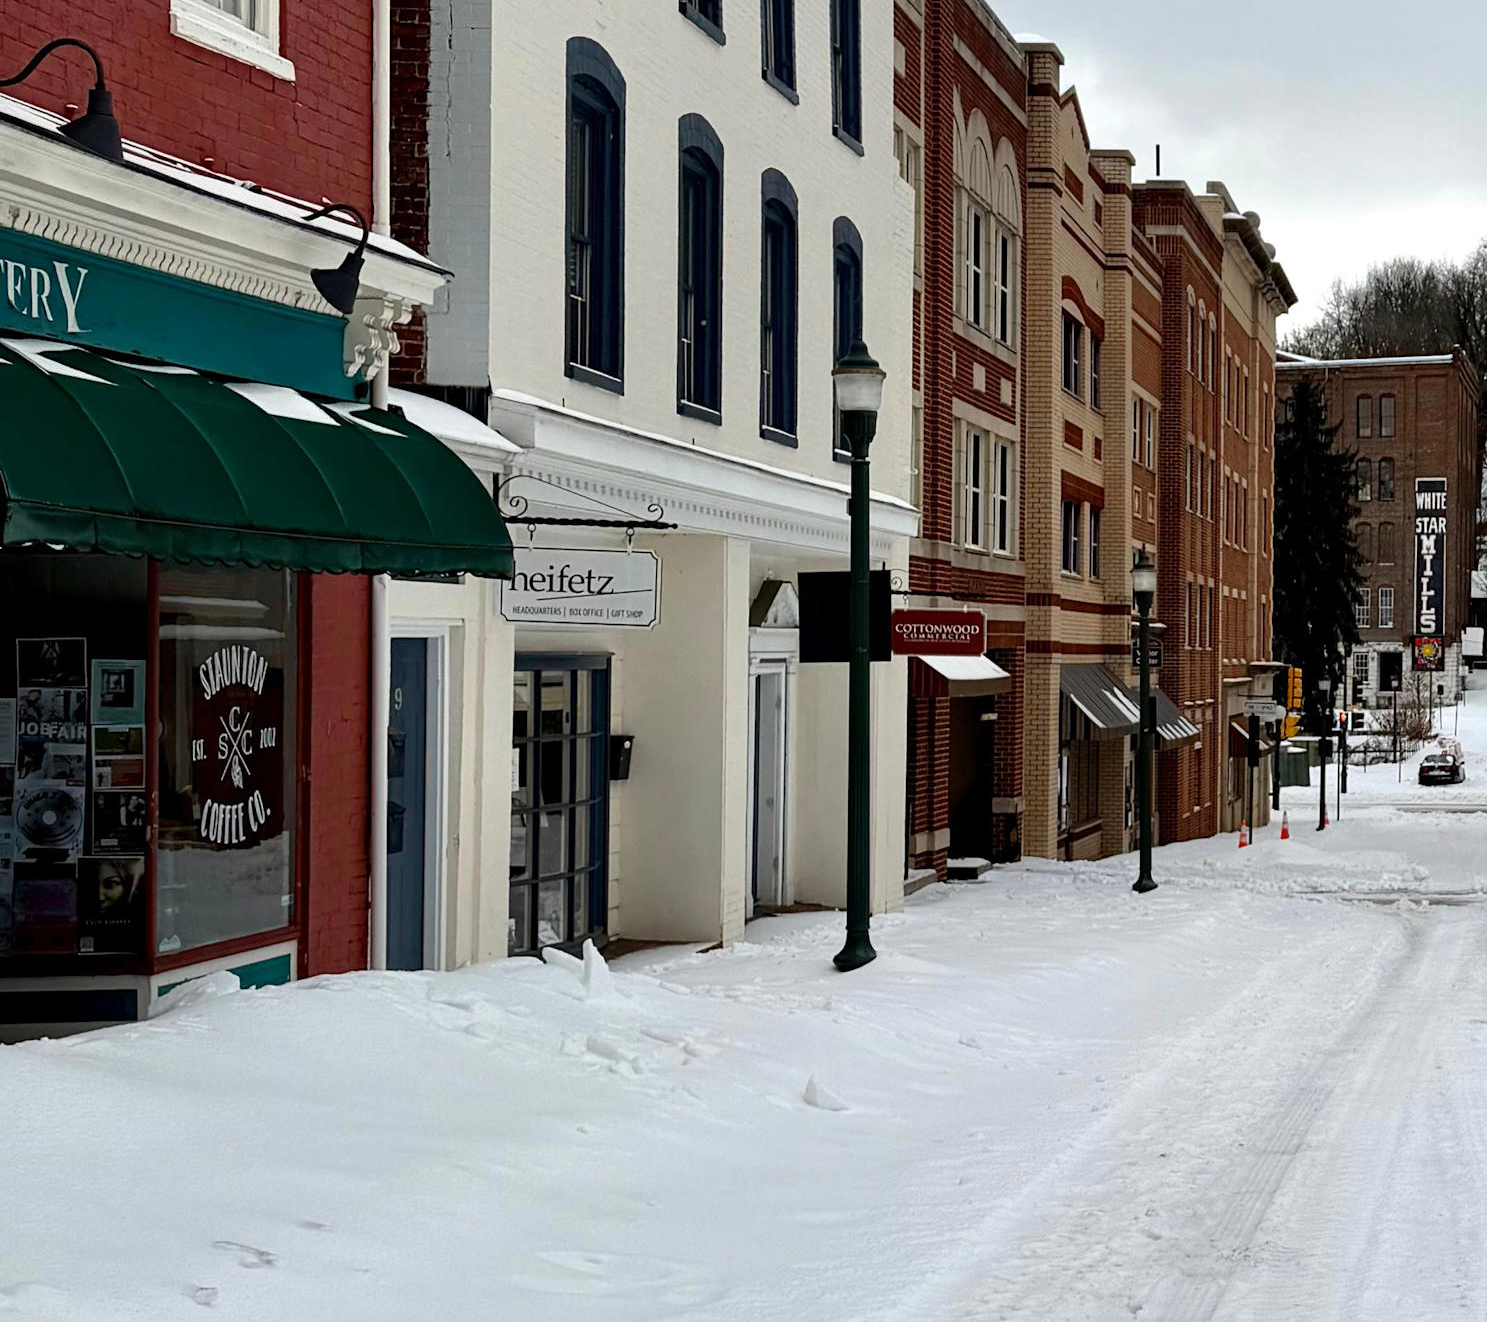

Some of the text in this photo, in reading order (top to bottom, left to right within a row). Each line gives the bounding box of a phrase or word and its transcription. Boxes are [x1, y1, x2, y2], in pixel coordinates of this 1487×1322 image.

[0, 259, 92, 333] ERY
[1415, 492, 1447, 510] WHITE
[1415, 517, 1447, 534] STAR
[508, 563, 615, 595] heifetz
[1420, 535, 1436, 634] MILLS
[512, 606, 562, 616] HEADQUARTERS
[569, 608, 604, 618] BOX OFFICE
[611, 609, 644, 618] GIFT SHOP
[895, 623, 980, 634] COTTONWOOD
[200, 645, 268, 700] STAUNTON
[395, 687, 402, 710] 9
[229, 706, 240, 732] C
[18, 722, 86, 740] JOB FAIR
[192, 739, 207, 761] EST.
[201, 789, 271, 844] COFFEE CO.
